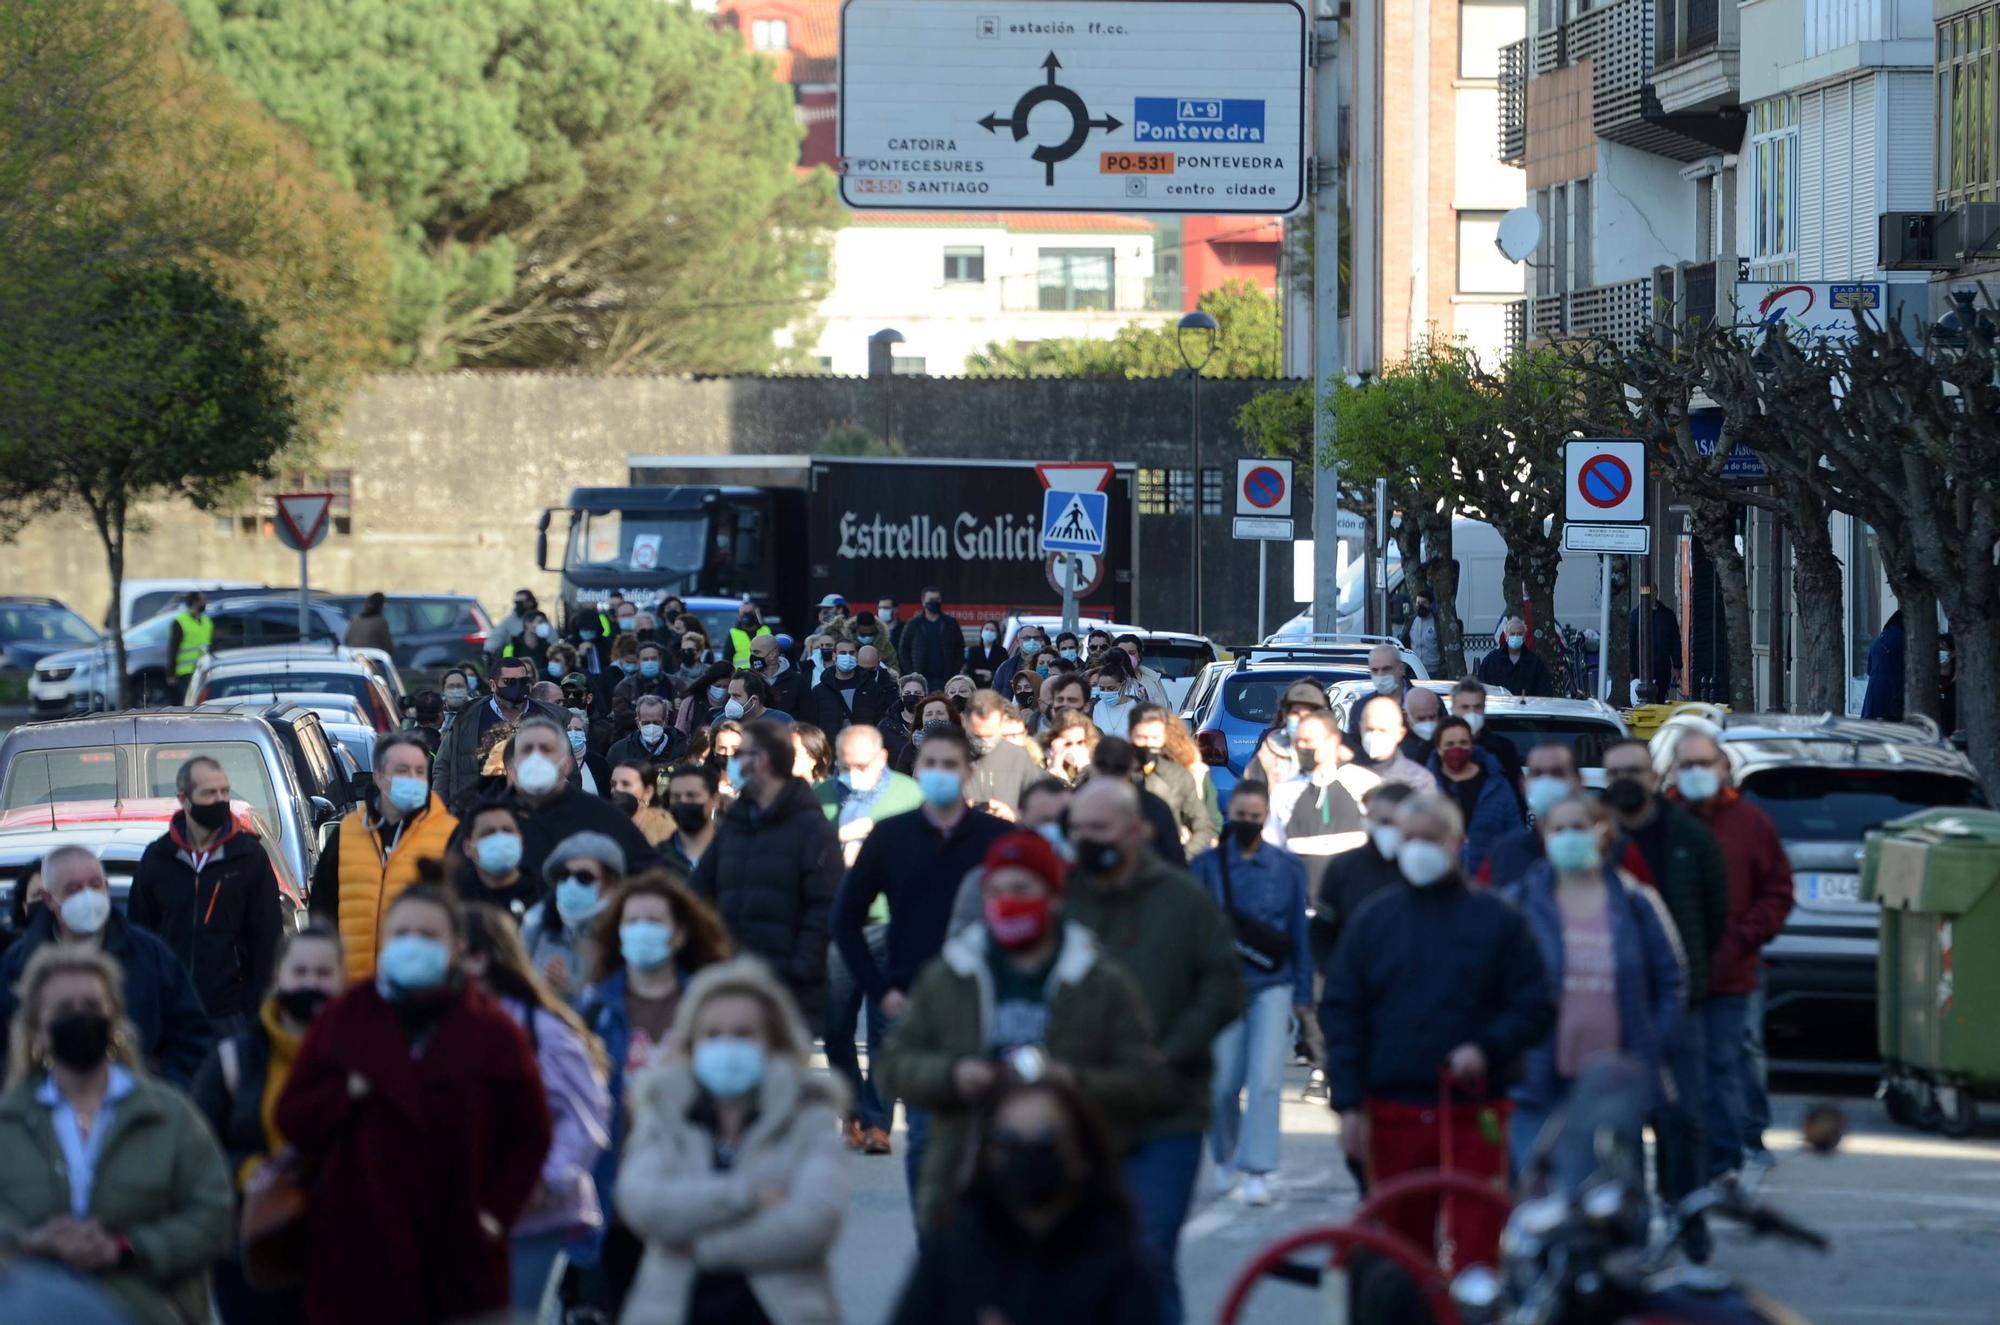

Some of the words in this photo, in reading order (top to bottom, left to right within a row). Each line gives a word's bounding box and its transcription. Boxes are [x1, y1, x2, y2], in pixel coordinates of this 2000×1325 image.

[1009, 20, 1075, 34] estación
[1088, 21, 1129, 34] ff.cc.
[1181, 102, 1218, 117] A-9
[1135, 120, 1261, 141] Pontevedra
[887, 138, 957, 151] CATOIRA
[857, 159, 984, 172] PONTECESURES
[1107, 156, 1167, 171] PO-531
[1177, 156, 1284, 169] PONTEVEDRA
[907, 181, 989, 194] SANTIAGO
[1166, 183, 1215, 195] centro
[1226, 183, 1276, 196] cidade
[1337, 518, 1356, 529] ción
[837, 510, 948, 560] Estrella
